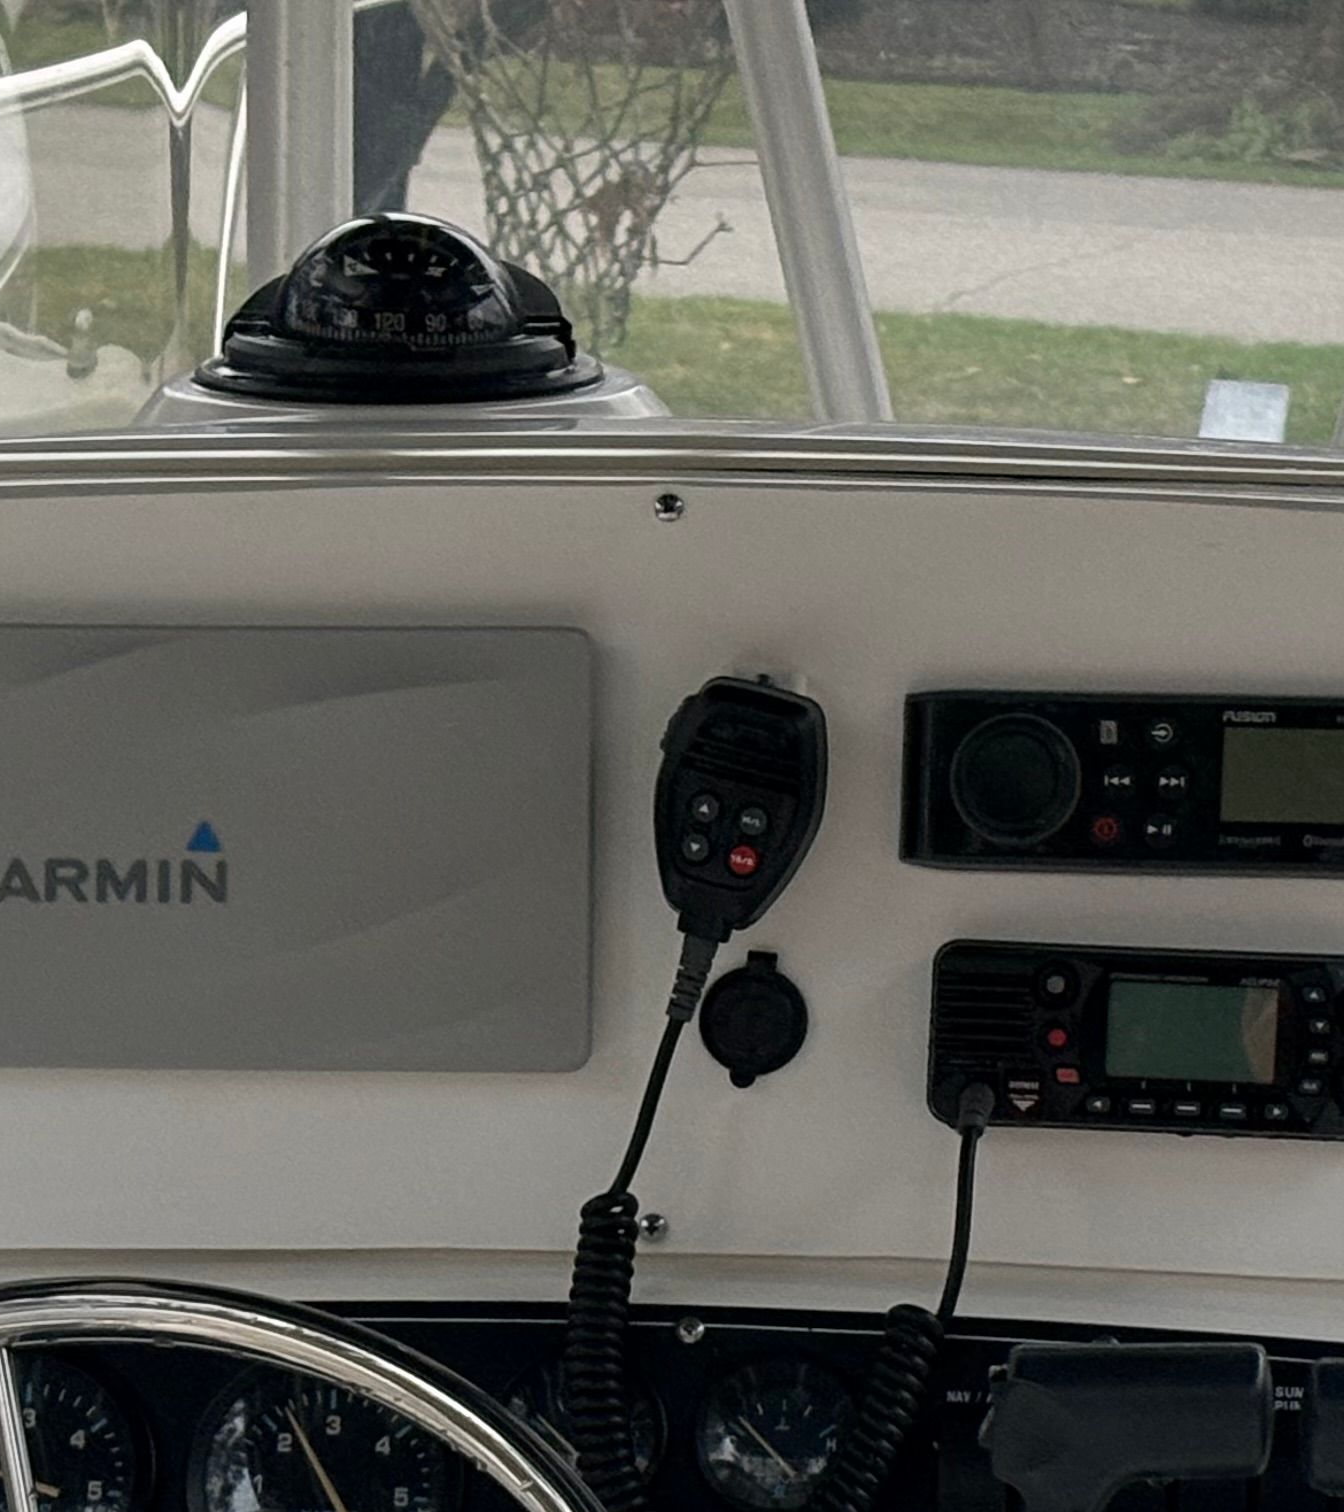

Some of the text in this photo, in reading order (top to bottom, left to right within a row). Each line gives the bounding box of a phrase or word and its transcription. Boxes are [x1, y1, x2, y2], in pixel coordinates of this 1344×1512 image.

[23, 1408, 37, 1428] 3
[325, 1415, 342, 1435] 3
[69, 1428, 86, 1450] 4
[276, 1432, 292, 1453] 2
[374, 1435, 391, 1456] 4
[87, 1480, 102, 1500] 5
[393, 1486, 409, 1507] 5
